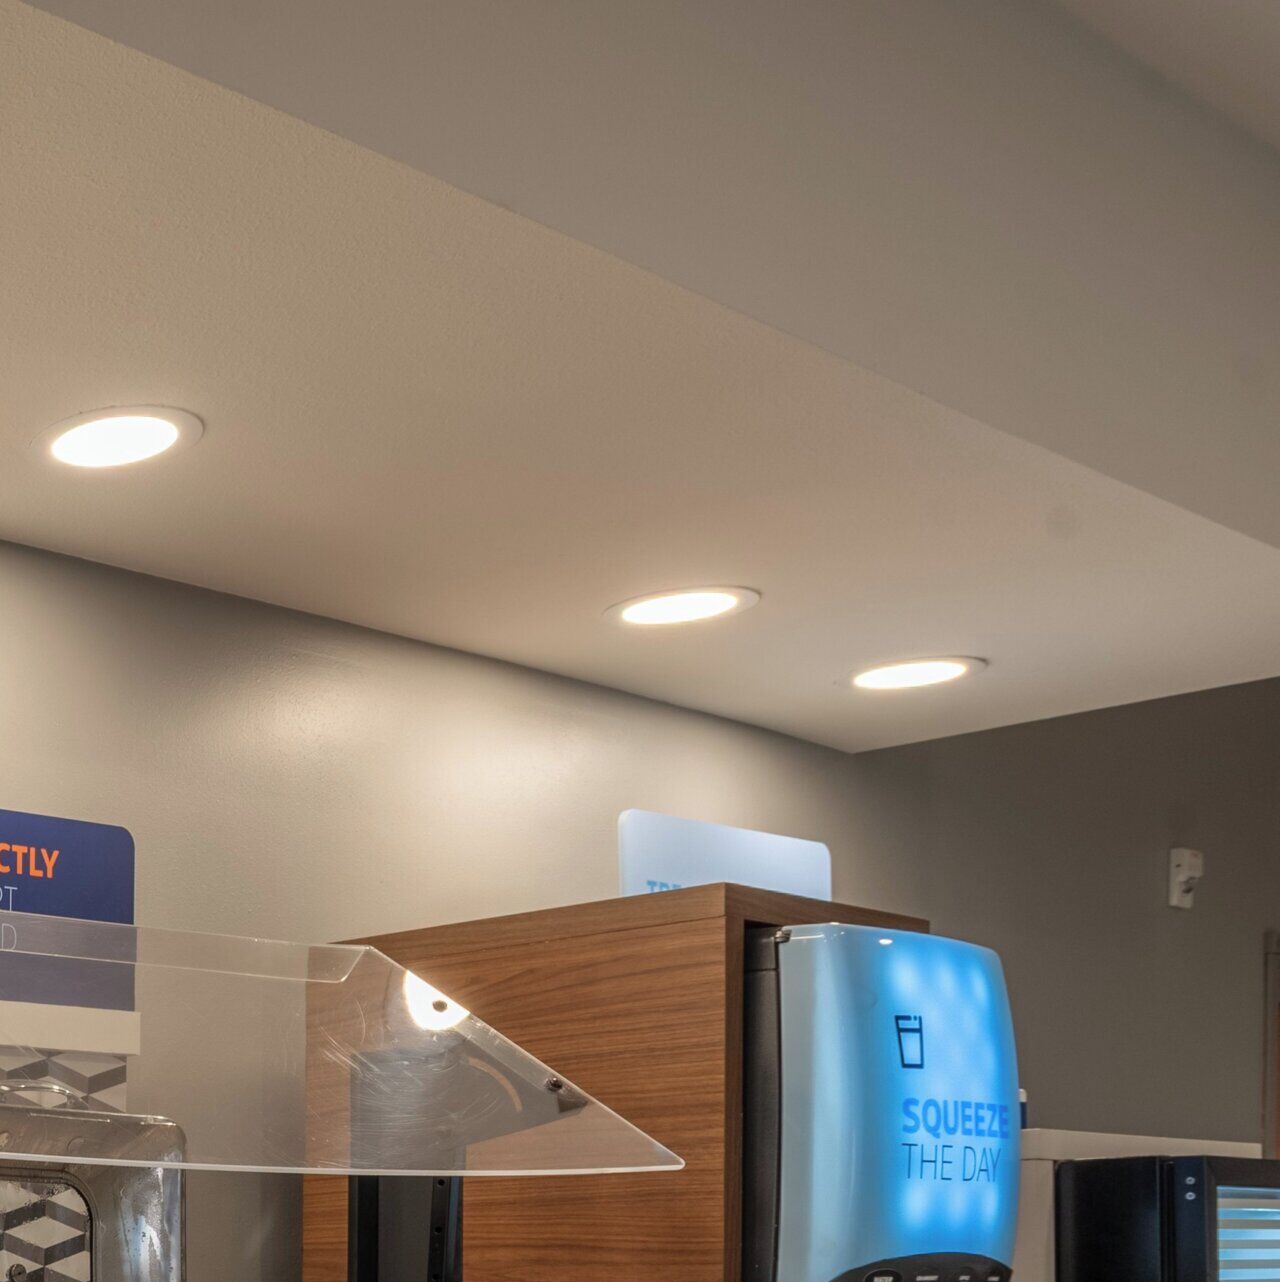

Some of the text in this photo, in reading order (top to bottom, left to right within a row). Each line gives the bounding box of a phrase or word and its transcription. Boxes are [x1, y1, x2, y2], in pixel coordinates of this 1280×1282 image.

[901, 1097, 1009, 1139] SQUEEZE
[901, 1143, 1001, 1182] THE DAY
